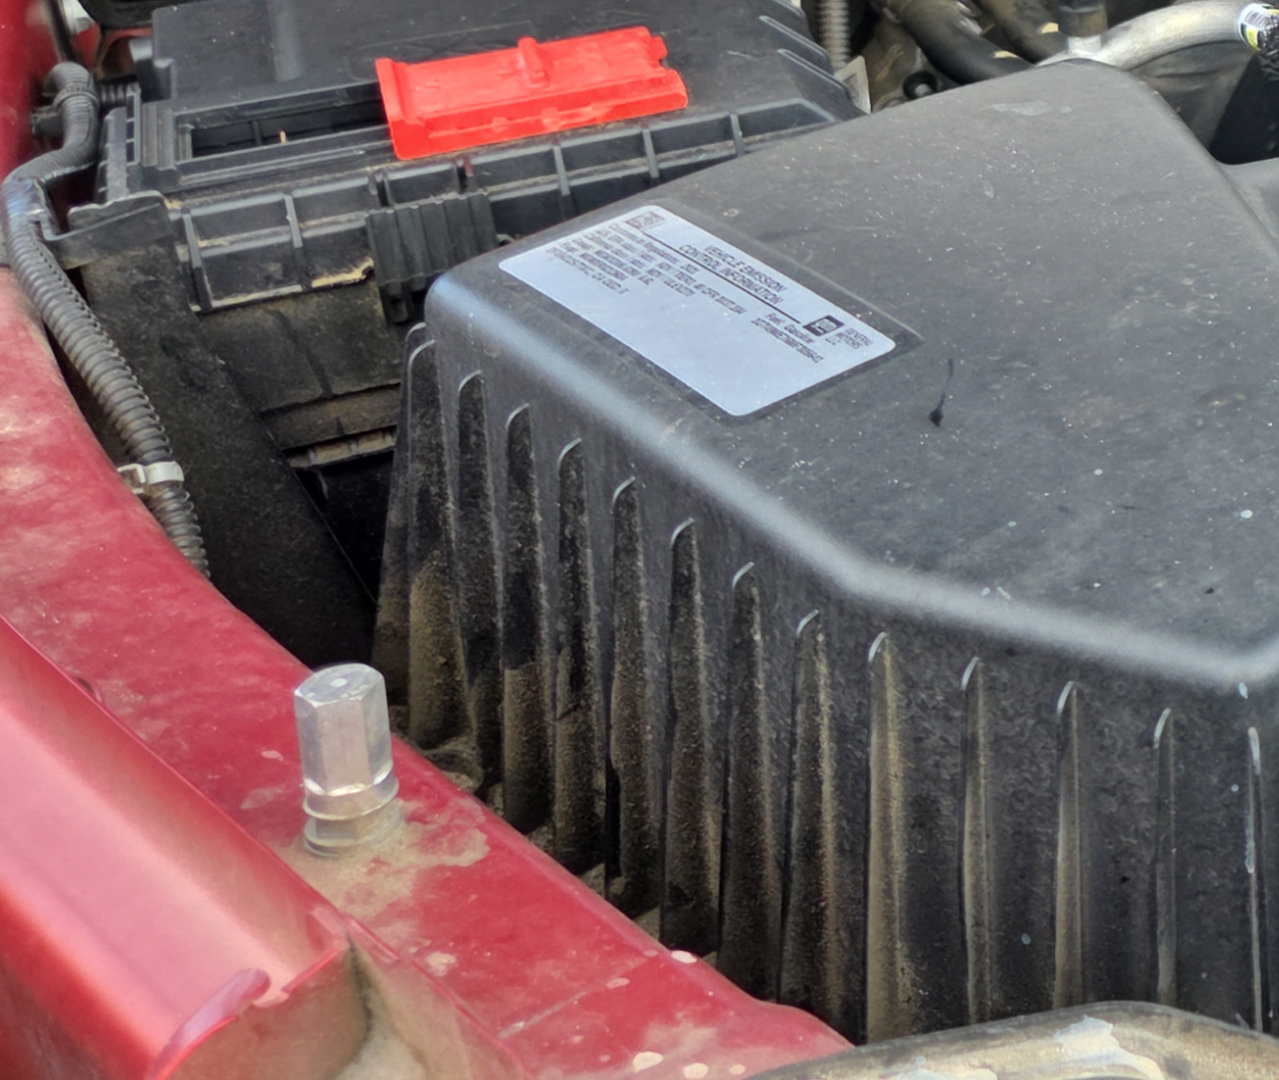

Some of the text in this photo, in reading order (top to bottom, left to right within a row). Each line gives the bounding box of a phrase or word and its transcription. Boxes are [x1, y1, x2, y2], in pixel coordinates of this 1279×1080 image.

[677, 243, 724, 269] CONTROL
[717, 266, 785, 304] INFORMATION
[701, 244, 789, 293] VEHICLE EMISSION
